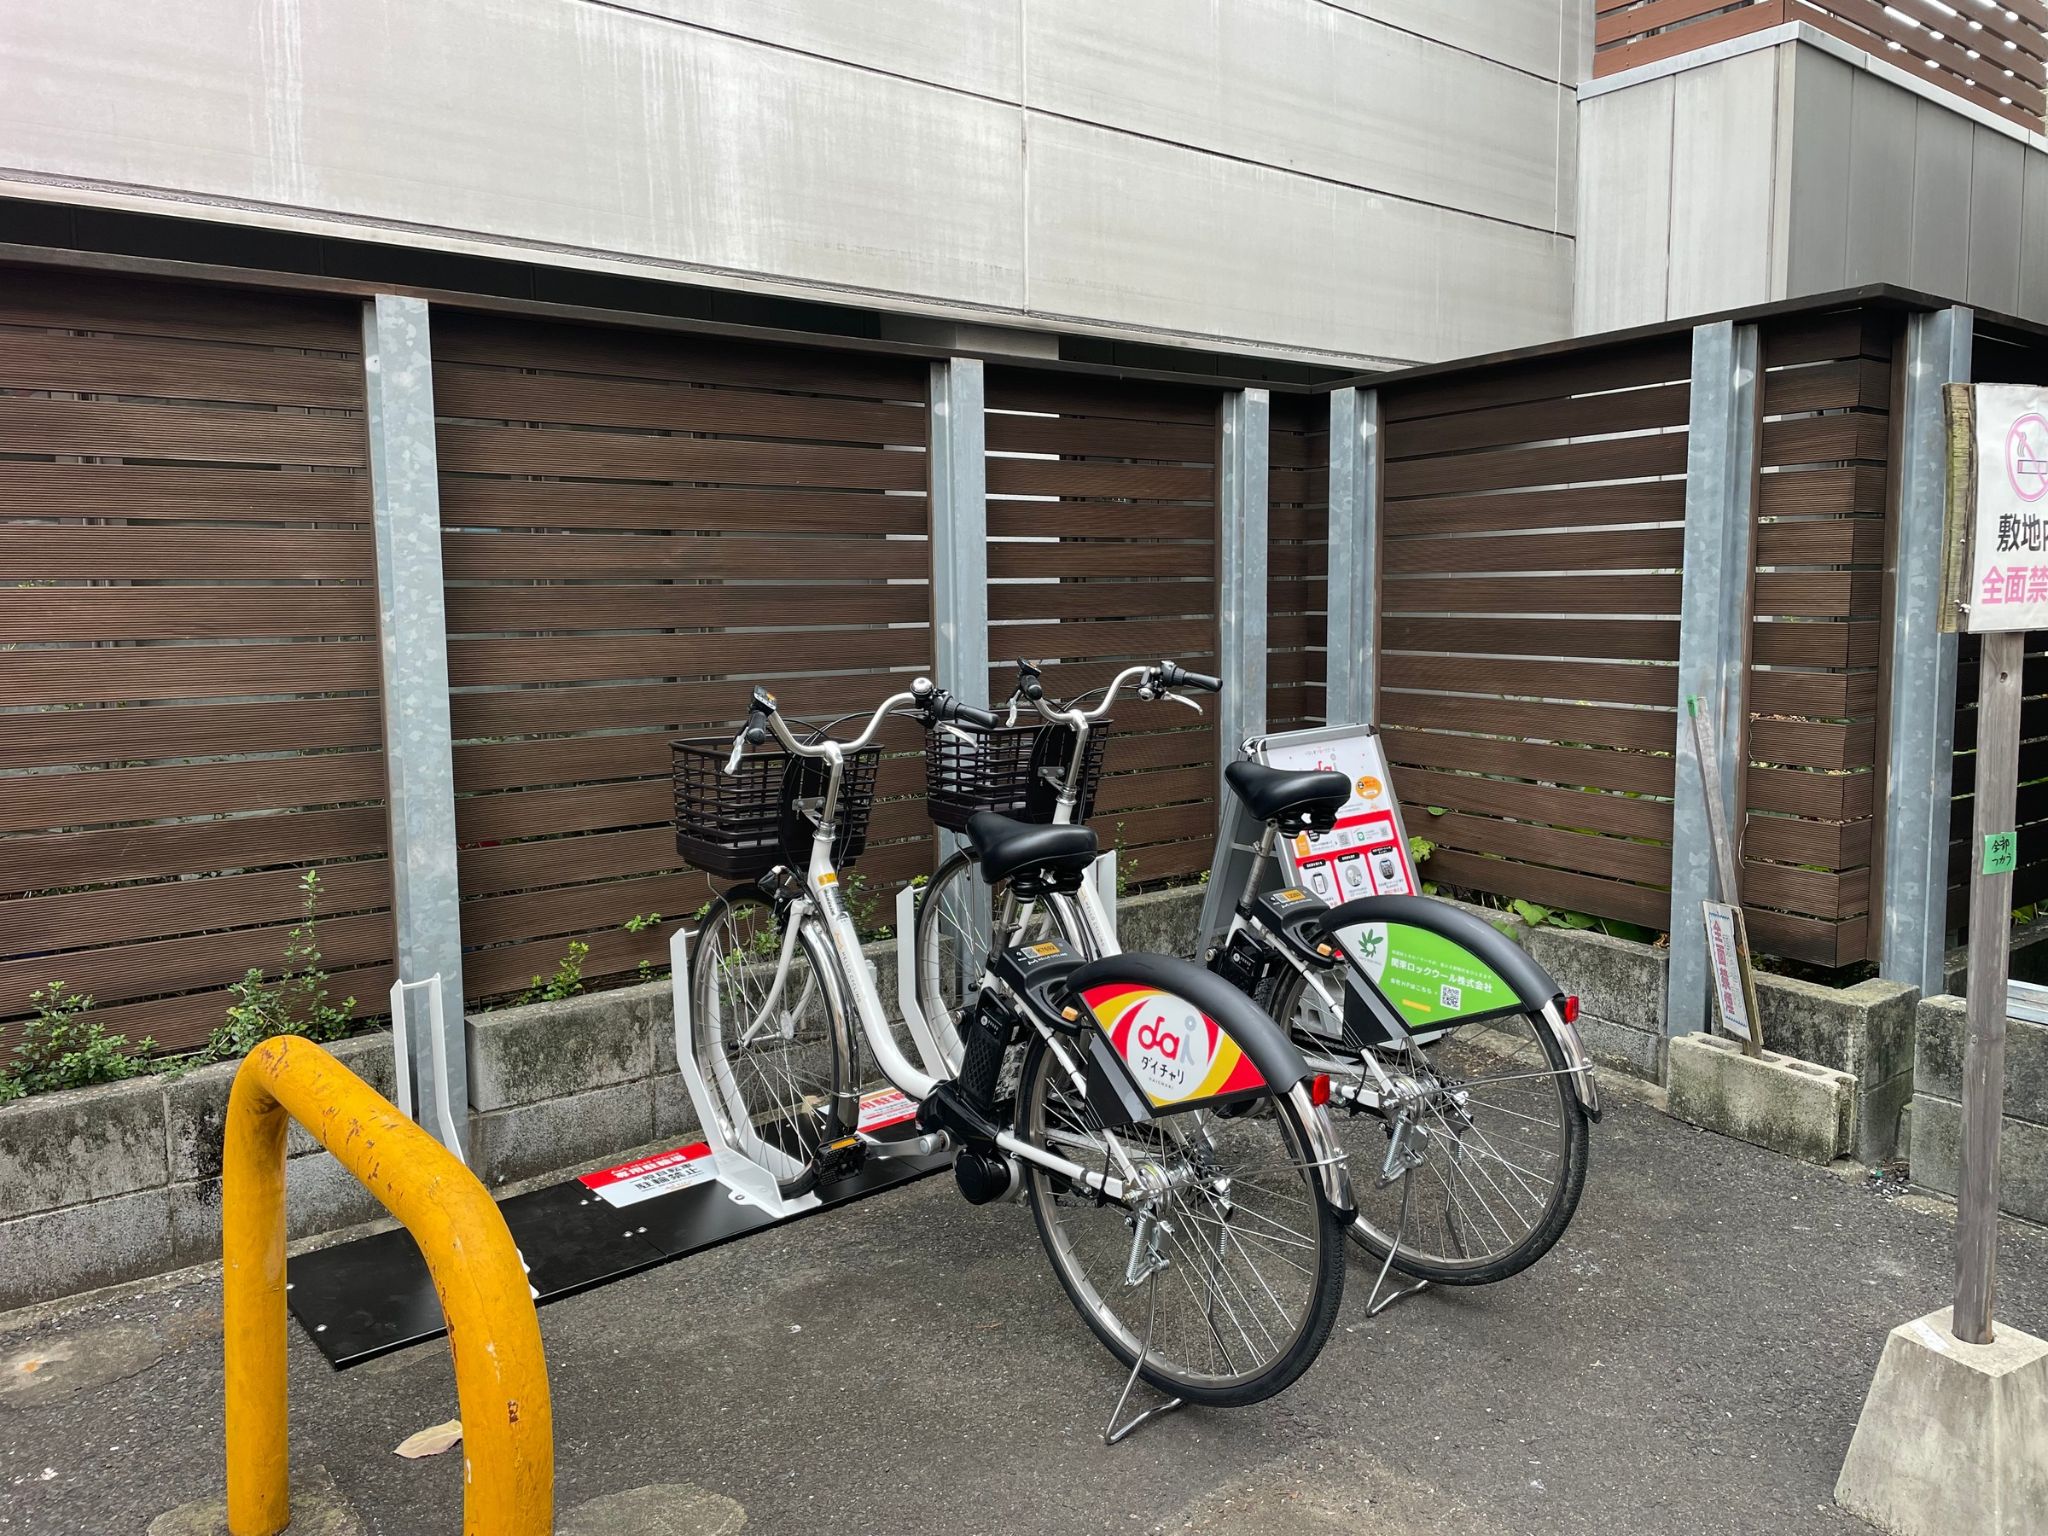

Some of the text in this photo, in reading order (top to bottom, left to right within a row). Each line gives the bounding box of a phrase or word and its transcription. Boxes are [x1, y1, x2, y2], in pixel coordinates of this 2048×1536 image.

[1996, 512, 2048, 553] 敷地
[1141, 1056, 1185, 1085] ダイチャリ
